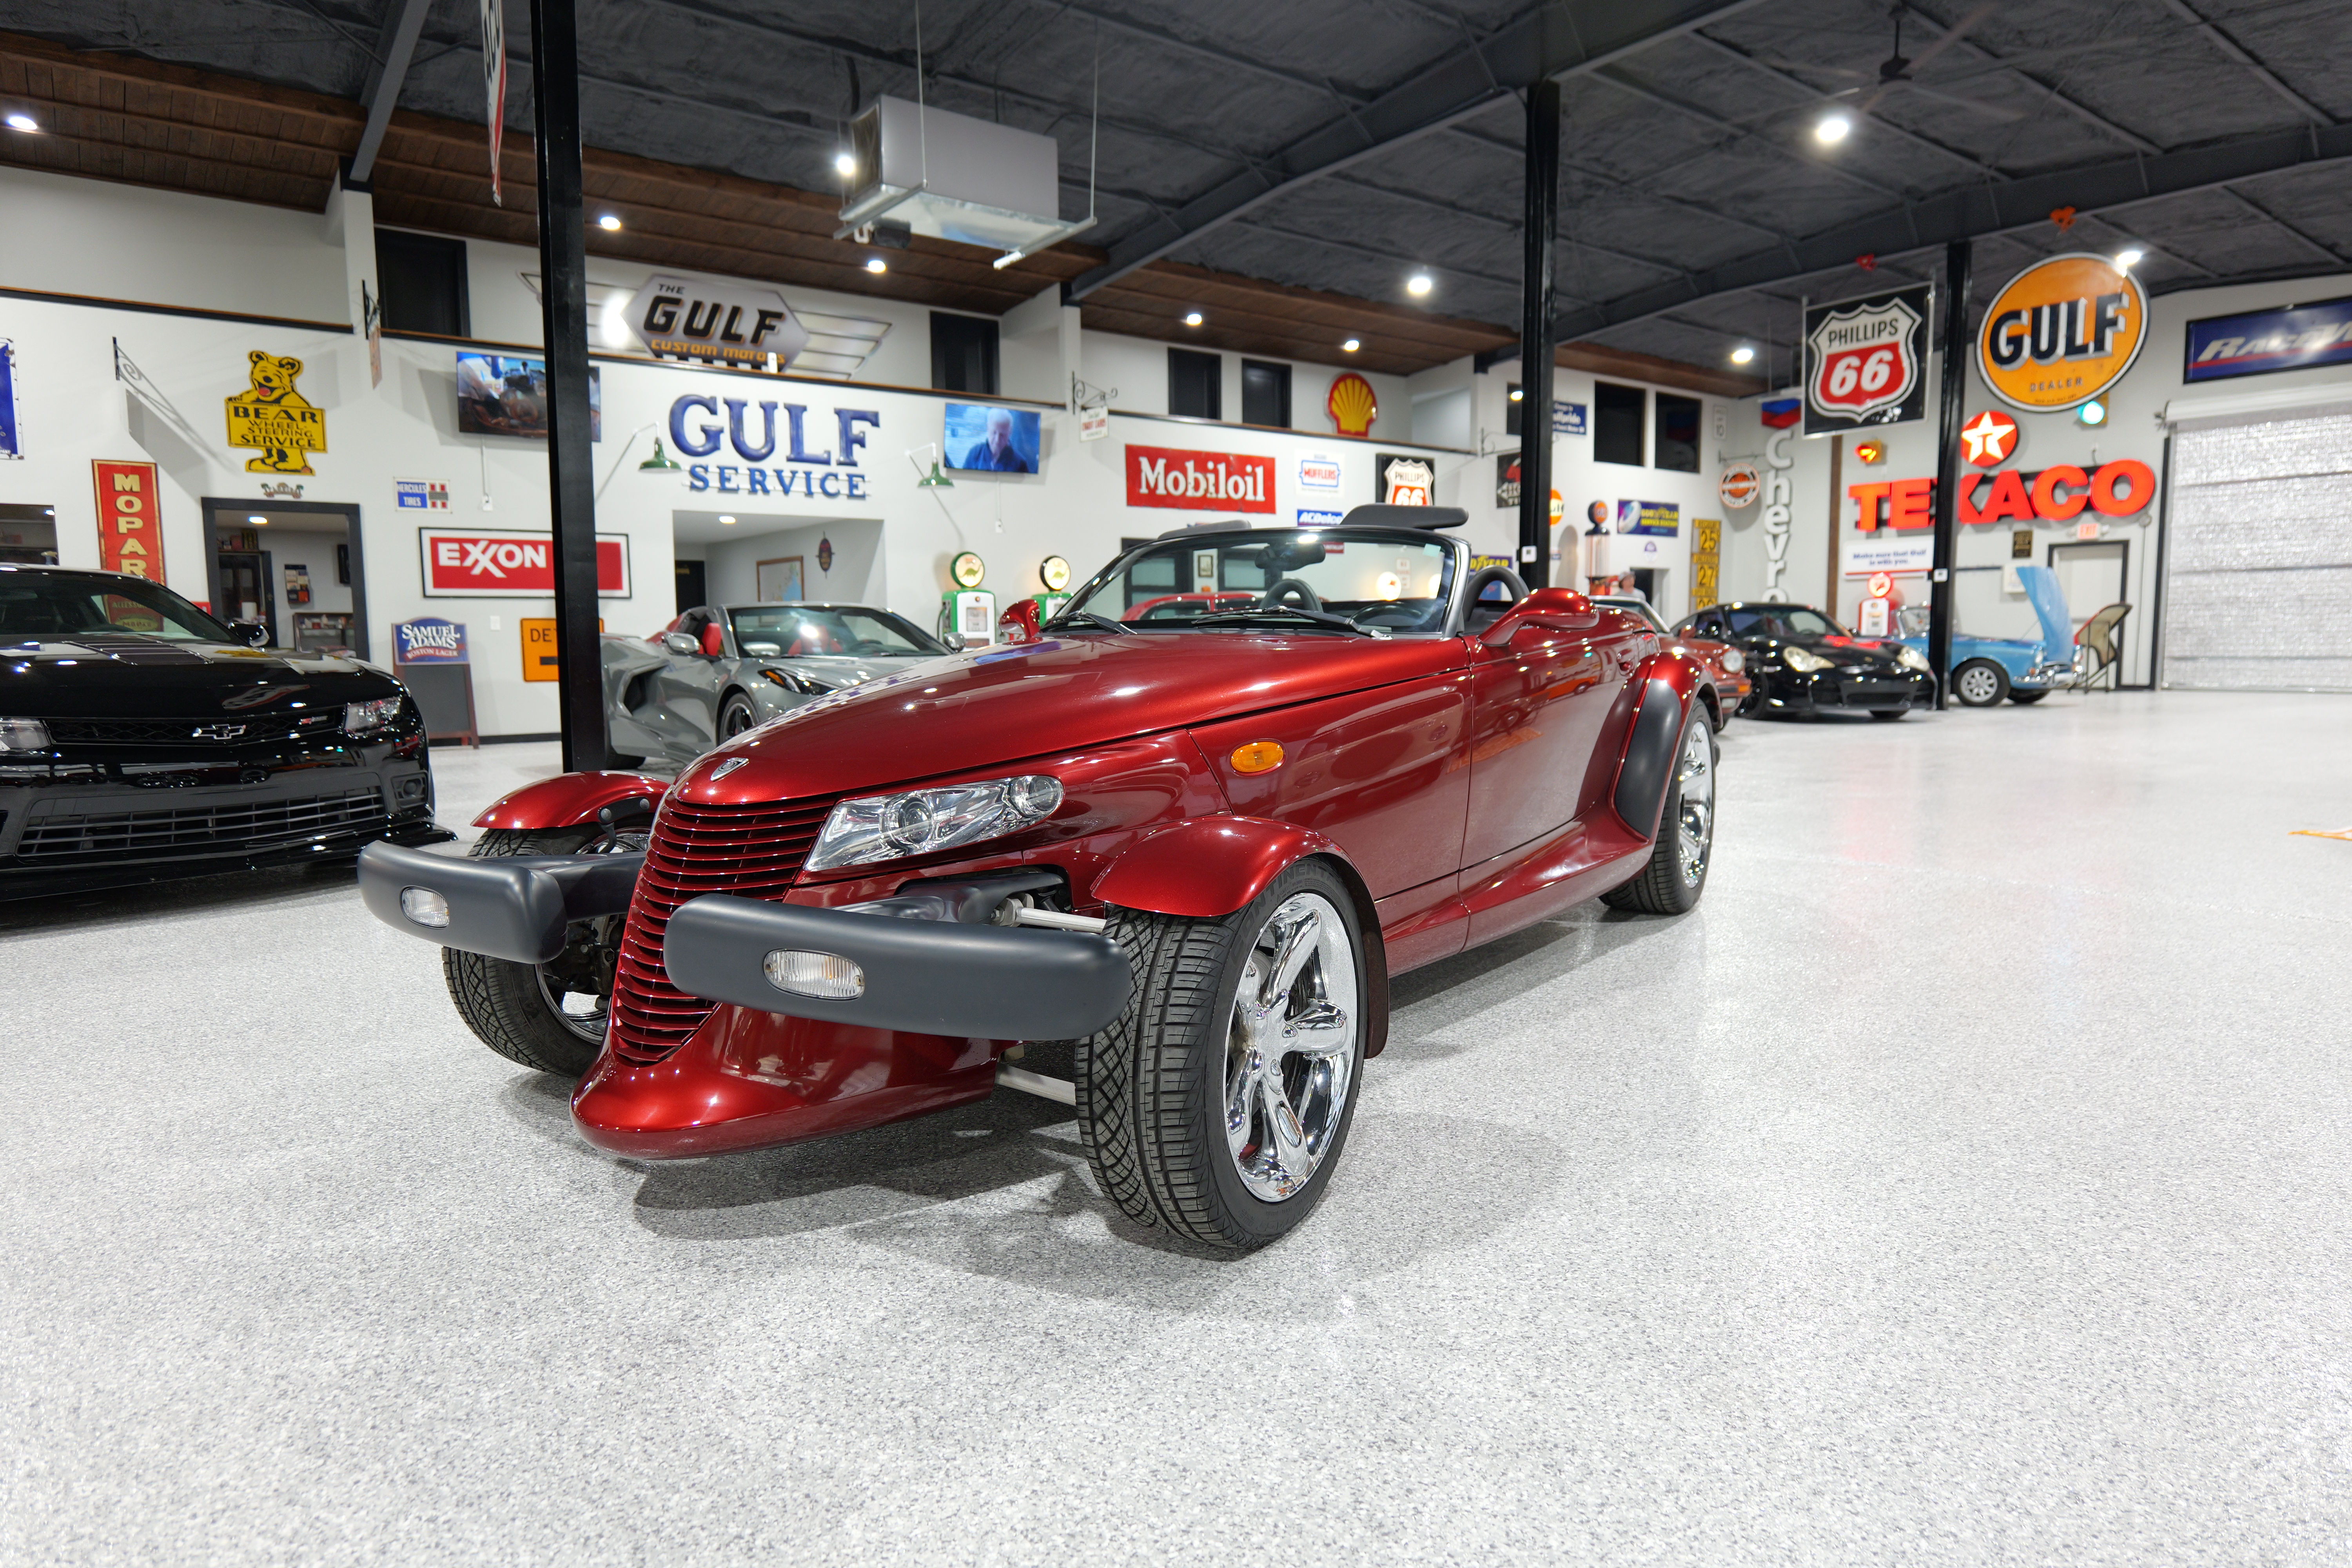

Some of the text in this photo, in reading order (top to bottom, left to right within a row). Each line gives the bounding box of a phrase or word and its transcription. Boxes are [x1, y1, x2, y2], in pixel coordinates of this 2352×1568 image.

[659, 283, 685, 295] THE
[644, 295, 786, 346] GULF
[1828, 318, 1899, 348] PHILLIPS
[1990, 291, 2129, 370] GULF
[651, 339, 785, 364] CUSTOM MOTOS
[1829, 350, 1894, 397] 66
[2030, 377, 2083, 392] DEALER
[234, 406, 318, 424] BEAR
[1553, 411, 1581, 426] ulfpride
[247, 426, 313, 438] STEERING
[669, 394, 880, 467] GULF
[240, 433, 316, 448] SERVICE
[689, 464, 867, 500] SERVICE
[1139, 456, 1265, 502] Mobiloil
[1304, 467, 1336, 480] MUFFLERS
[1395, 471, 1425, 483] PHILLIPS
[397, 482, 427, 494] HERCULES
[1395, 487, 1425, 506] 66
[403, 496, 422, 507] TIRES
[113, 472, 149, 576] MOPAR
[1298, 510, 1343, 524] ACDelco
[437, 539, 547, 578] EXXON
[401, 623, 461, 640] SAMUEL
[407, 636, 457, 651] ADAMS
[406, 647, 459, 660] BOSTON LAGER
